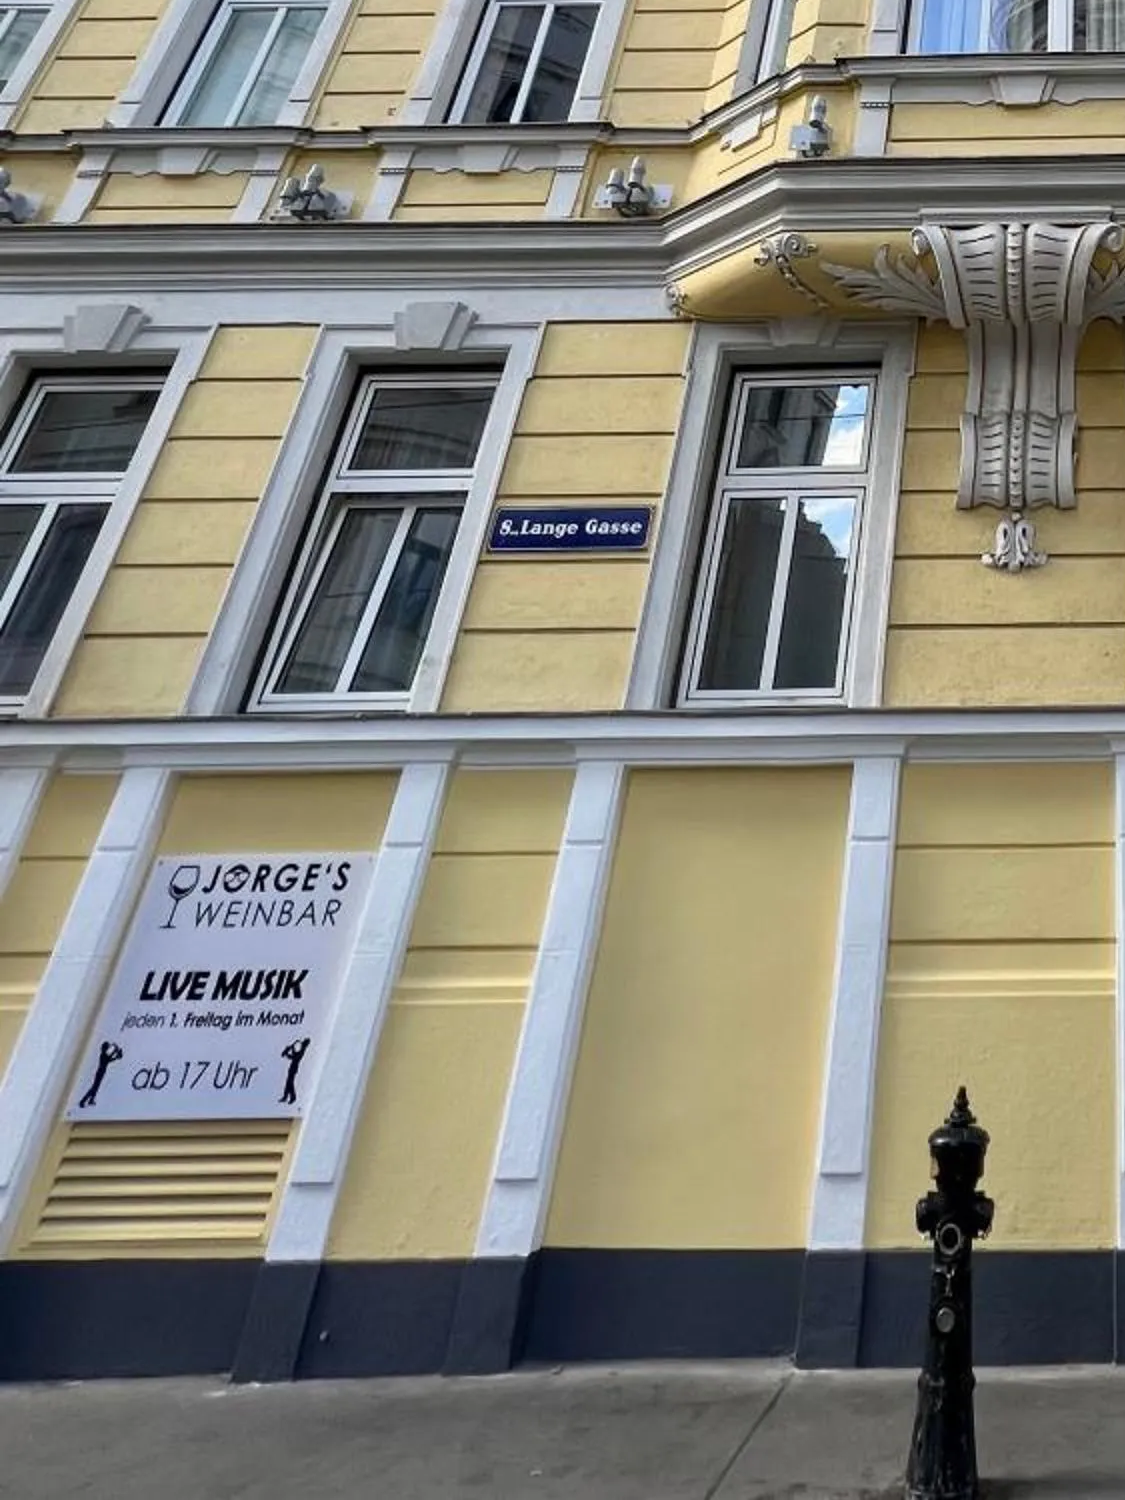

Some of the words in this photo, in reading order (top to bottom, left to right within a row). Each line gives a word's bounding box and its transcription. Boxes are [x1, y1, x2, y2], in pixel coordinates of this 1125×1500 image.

[520, 519, 579, 539] Lange
[585, 518, 643, 535] Gasse
[202, 861, 351, 894] JORGE'S
[194, 899, 342, 928] WEINBAR
[139, 970, 210, 1001] LIVE
[211, 969, 309, 1000] MUSIK
[120, 1011, 164, 1031] jeden
[184, 1011, 233, 1031] Freitag
[235, 1010, 253, 1027] im
[255, 1009, 305, 1027] Monat
[131, 1061, 170, 1091] ab
[179, 1061, 210, 1090] 17
[213, 1061, 259, 1090] Uhr
